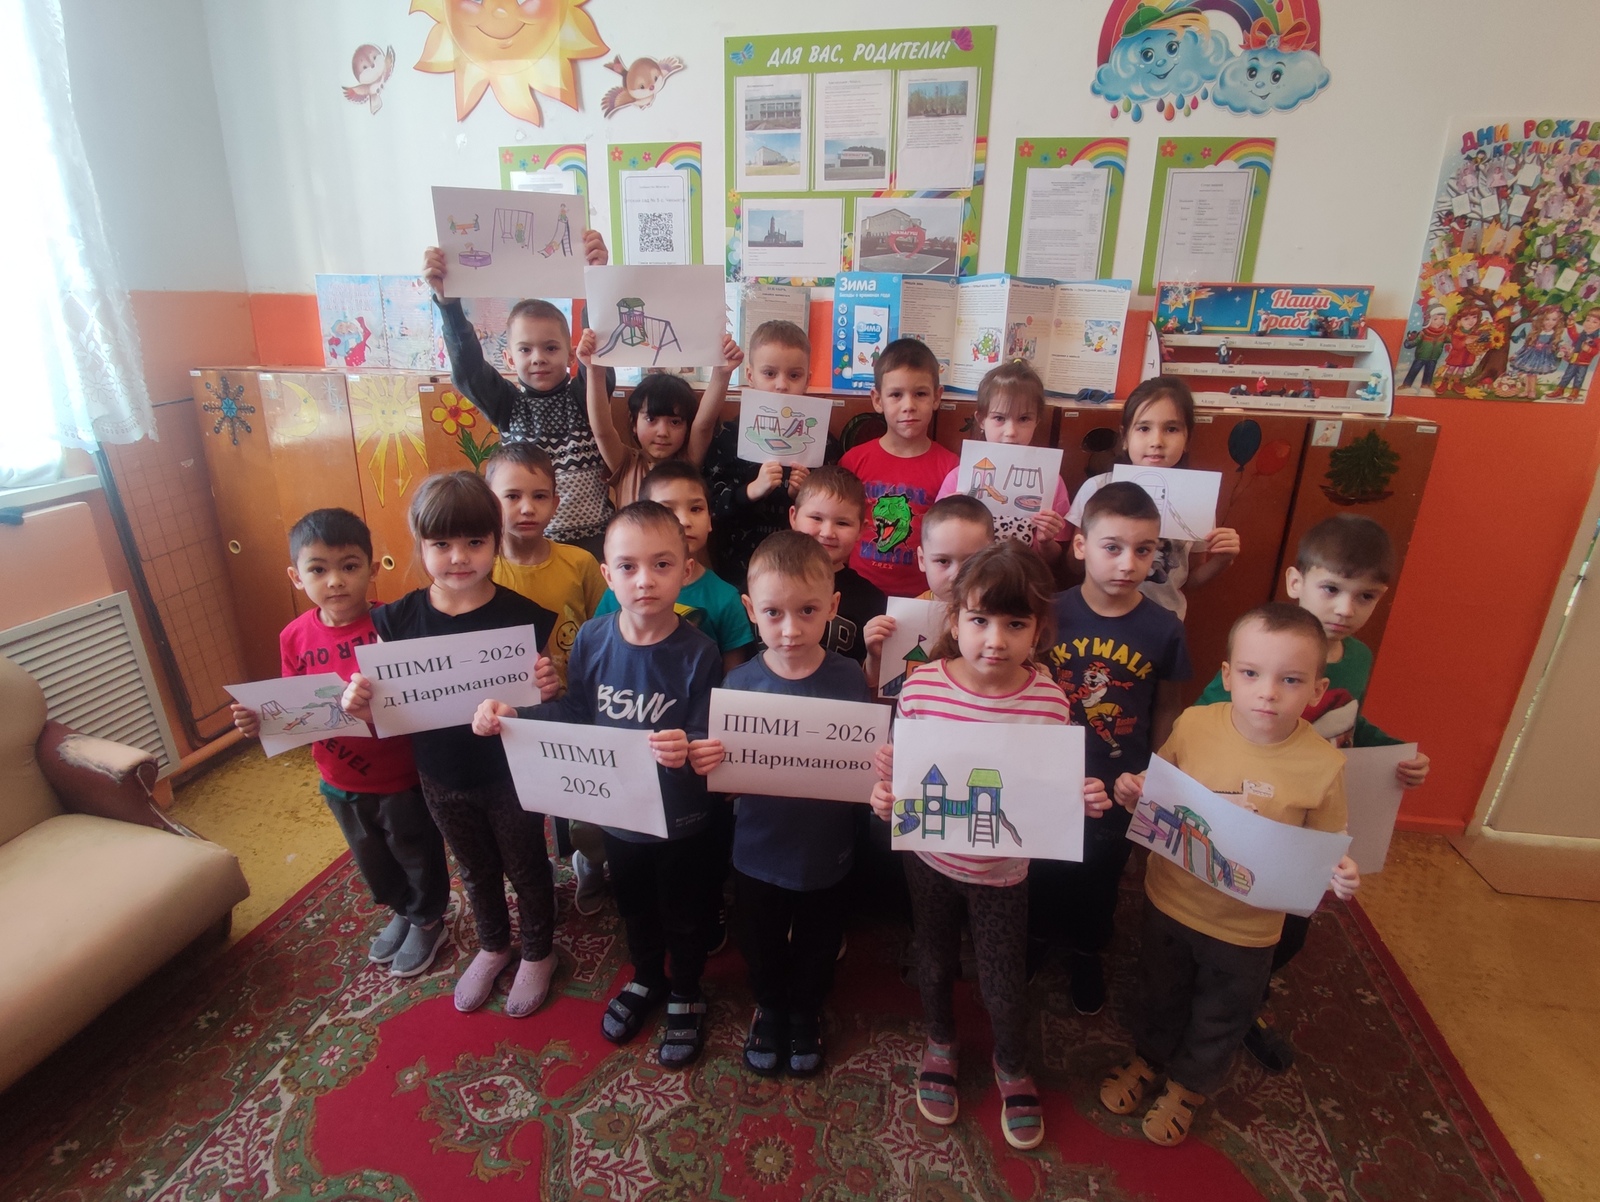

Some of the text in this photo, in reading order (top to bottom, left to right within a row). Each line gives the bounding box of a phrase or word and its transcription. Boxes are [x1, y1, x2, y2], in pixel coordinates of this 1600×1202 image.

[766, 40, 951, 67] ДЛЯ ВАС, РОДИТЕЛИ!
[1461, 123, 1510, 155] ДНИ
[1493, 139, 1564, 158] КРУГЛЫЙ
[839, 277, 877, 292] Зима
[1271, 289, 1330, 310] Наши
[860, 324, 881, 332] Зима
[1265, 310, 1345, 334] рабоы
[374, 654, 453, 682] ППМИ
[478, 642, 527, 665] 2026
[383, 671, 530, 709] д.Нариманово
[723, 713, 800, 737] ППМИ
[825, 723, 877, 743] 2026
[318, 738, 373, 777] EVEL
[538, 741, 619, 769] ППМИ
[721, 748, 872, 771] д.Нариманово
[560, 776, 612, 799] 2026
